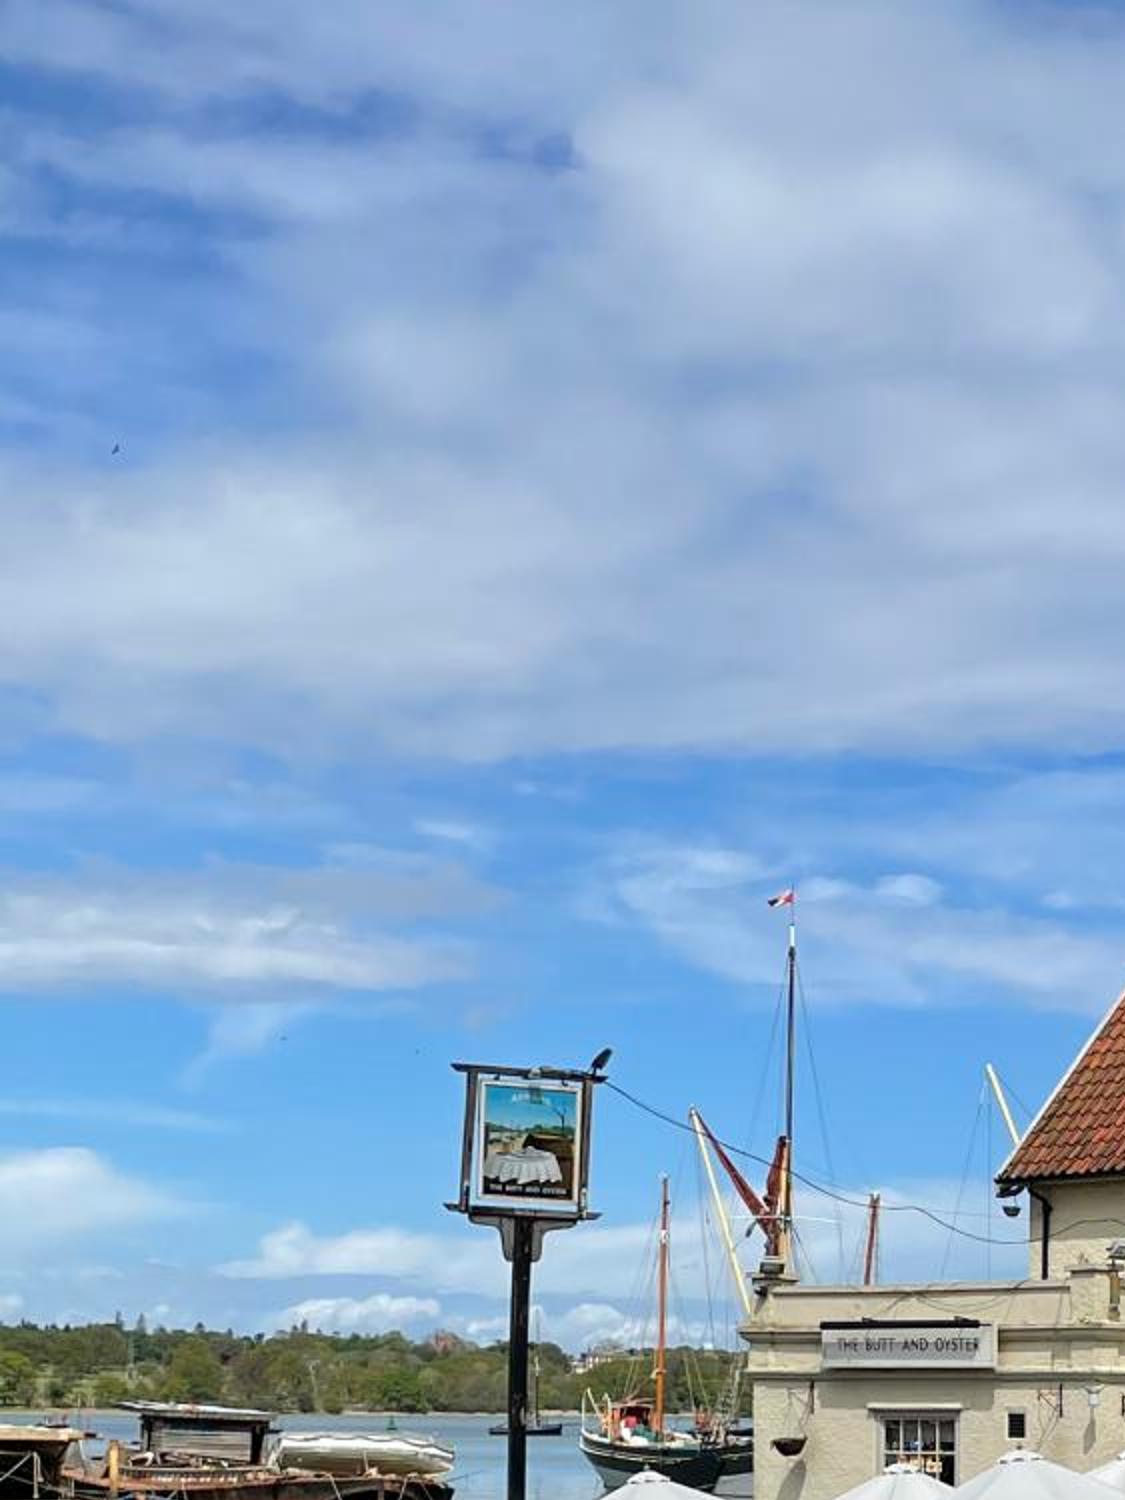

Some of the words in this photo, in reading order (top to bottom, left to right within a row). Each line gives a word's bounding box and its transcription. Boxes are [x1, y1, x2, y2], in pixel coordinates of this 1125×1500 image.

[837, 1338, 859, 1353] THE
[865, 1337, 896, 1353] BUTT
[902, 1337, 929, 1353] AND
[935, 1337, 980, 1353] OYSTER
